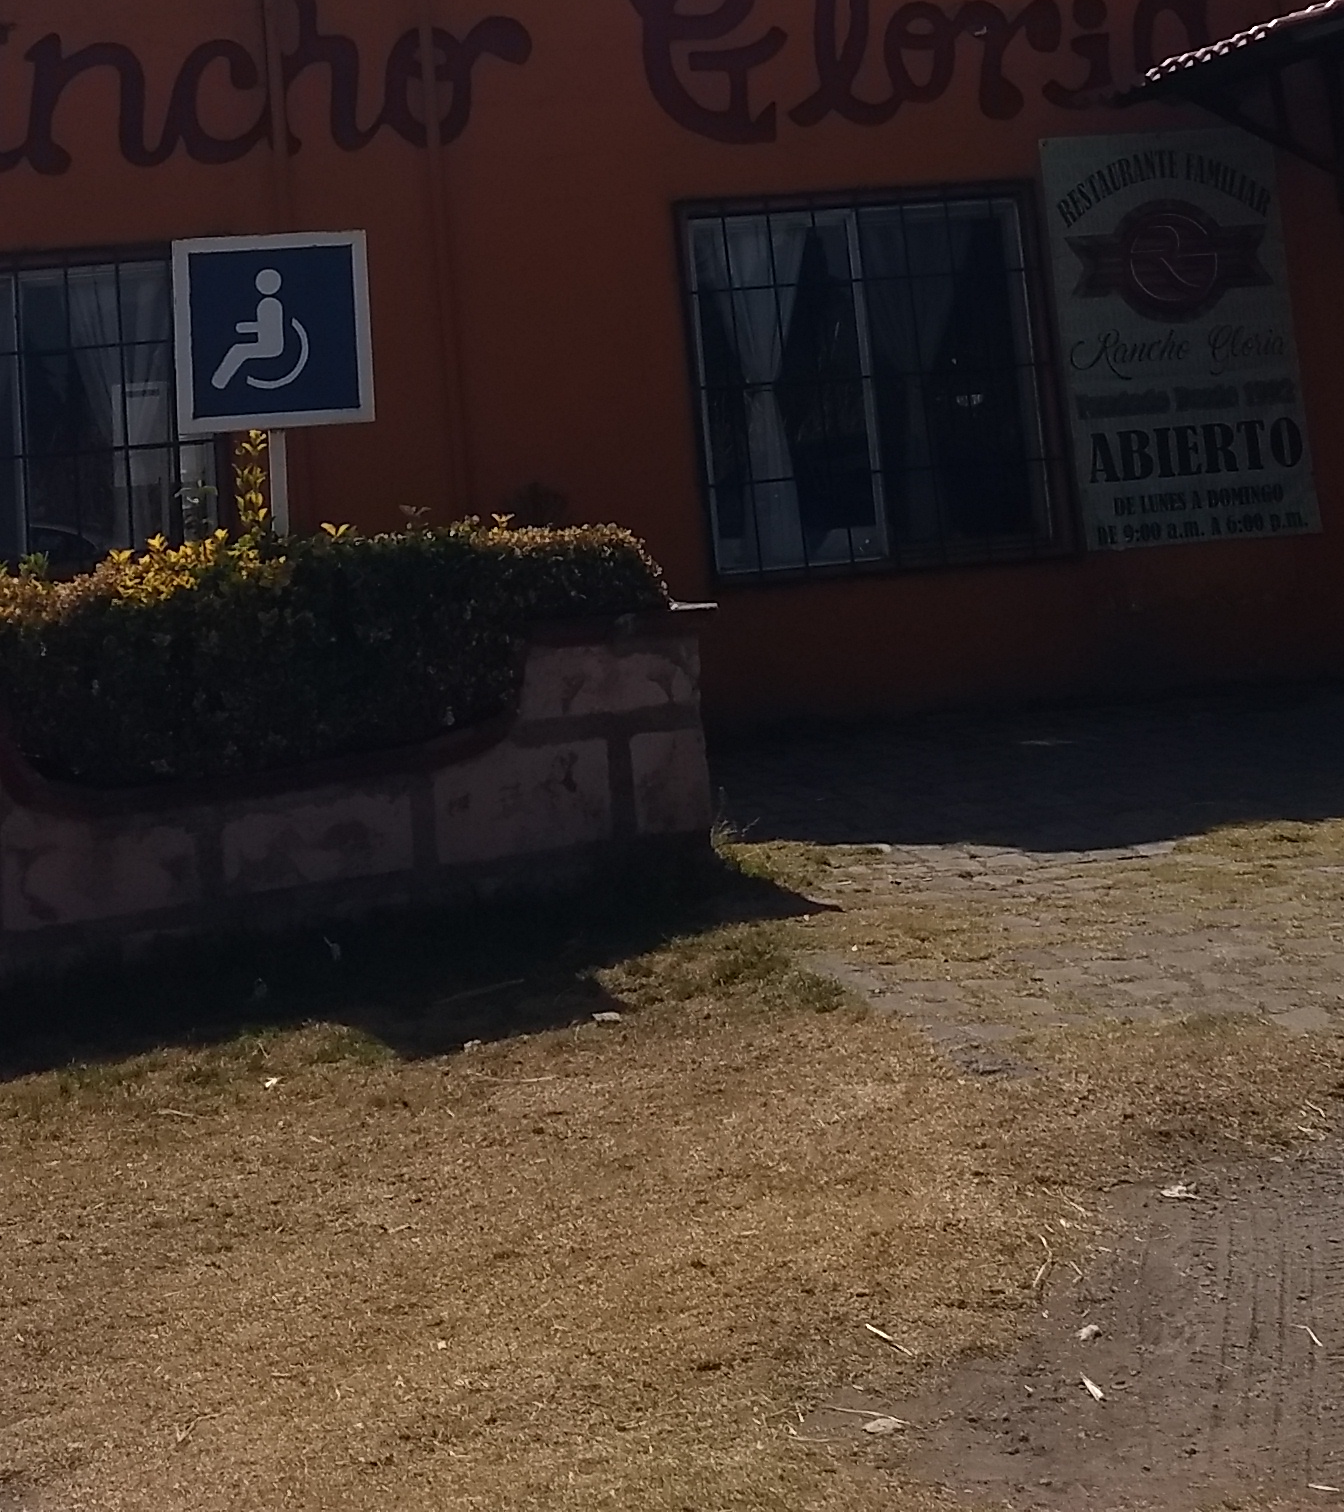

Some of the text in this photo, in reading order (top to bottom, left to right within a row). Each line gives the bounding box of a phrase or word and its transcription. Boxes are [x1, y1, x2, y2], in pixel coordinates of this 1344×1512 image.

[1057, 150, 1273, 229] RESTAURANTE FAMILIAR
[1070, 324, 1286, 380] Rancho Gloria
[1089, 417, 1304, 484] ABIERTO
[1114, 484, 1284, 516] DE LUNES A DOMINGO
[1097, 511, 1309, 546] DE 9:00 a.m. A 6:00 p.m.
